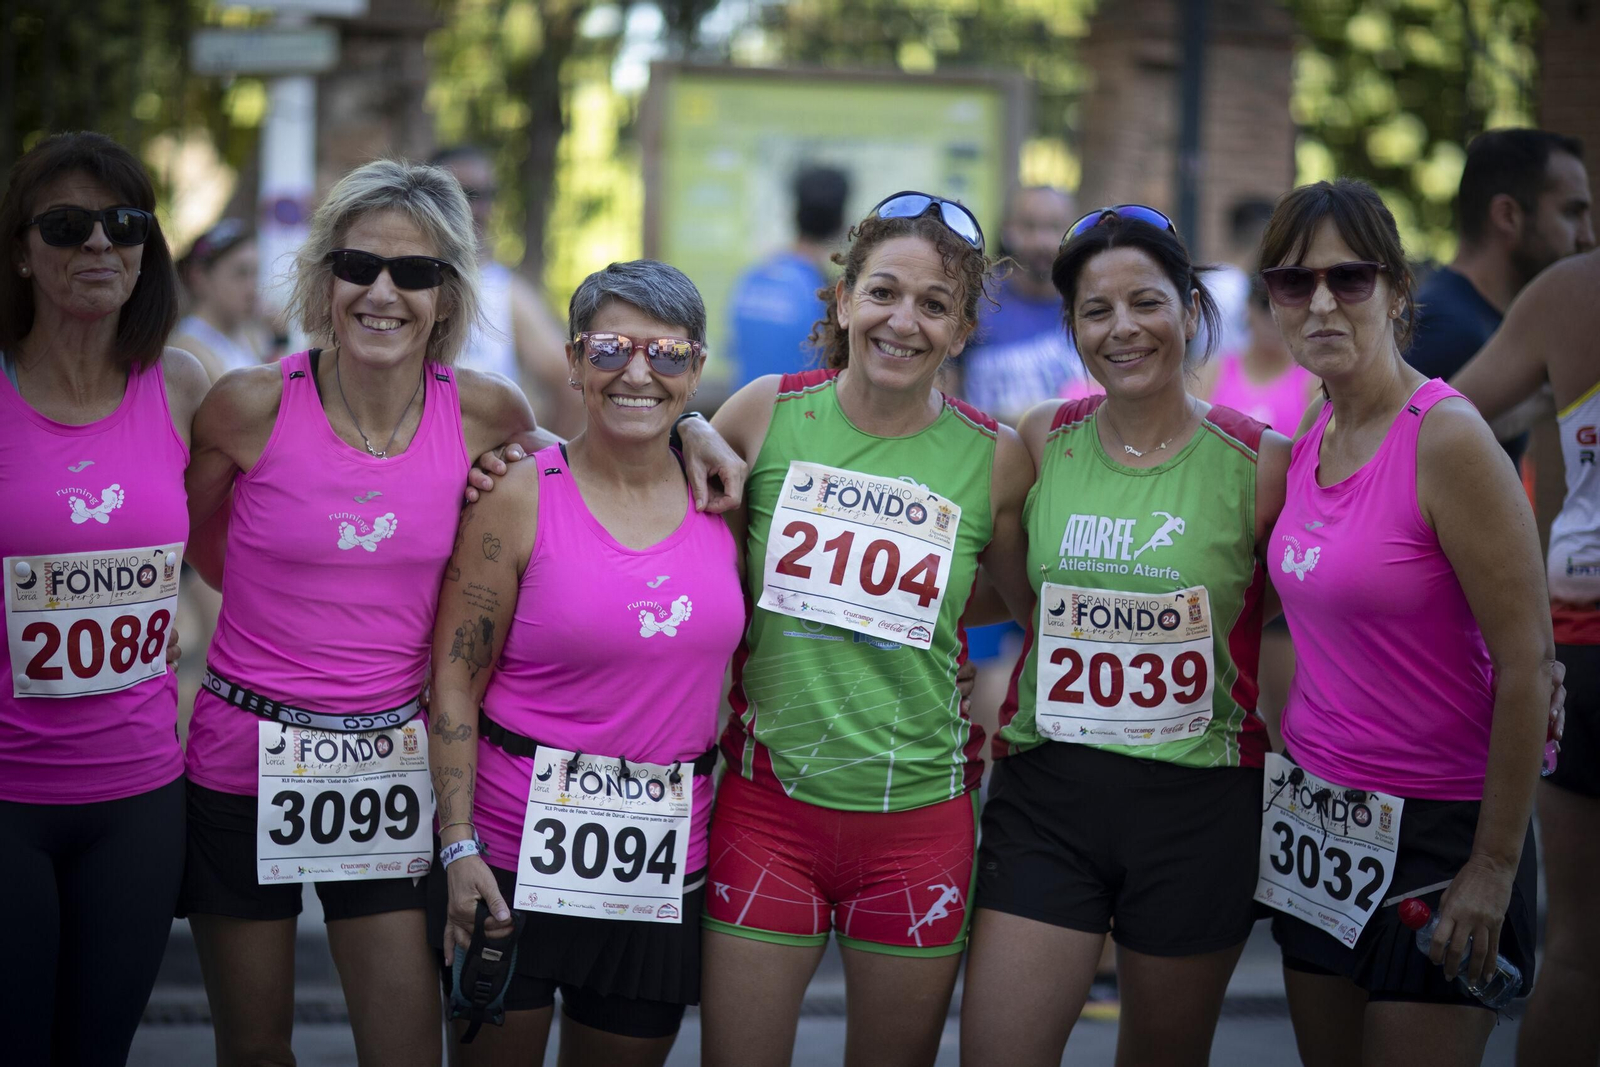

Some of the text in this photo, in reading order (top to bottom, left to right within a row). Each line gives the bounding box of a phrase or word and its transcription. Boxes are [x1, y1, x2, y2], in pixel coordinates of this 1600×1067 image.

[56, 487, 99, 506] running
[829, 475, 864, 489] GRAN
[868, 481, 912, 500] PREMIO
[822, 482, 927, 525] FONDO
[910, 508, 923, 519] 24
[328, 512, 370, 533] running
[1059, 514, 1136, 561] ATARFE
[1282, 535, 1302, 560] running
[51, 560, 89, 572] GRAN
[93, 556, 138, 570] PREMIO
[775, 521, 941, 608] 2104
[1058, 558, 1180, 580] Atletismo Atarfe
[52, 564, 157, 595] FONDO
[142, 571, 153, 581] 24
[626, 600, 668, 618] running
[1078, 594, 1110, 607] GRAN
[1115, 597, 1159, 611] PREMIO
[843, 609, 873, 622] Cruzcampo
[1077, 602, 1181, 631] FONDO
[1163, 615, 1175, 625] 24
[21, 609, 171, 681] 2088
[1048, 648, 1208, 708] 2039
[300, 730, 338, 740] GRAN
[301, 734, 393, 763] FONDO
[377, 741, 389, 752] 24
[576, 761, 602, 773] RAN
[565, 768, 665, 802] FONDO
[649, 785, 661, 797] 24
[269, 784, 420, 846] 3099
[1355, 810, 1369, 821] 24
[530, 818, 677, 884] 3094
[1270, 821, 1385, 913] 3032
